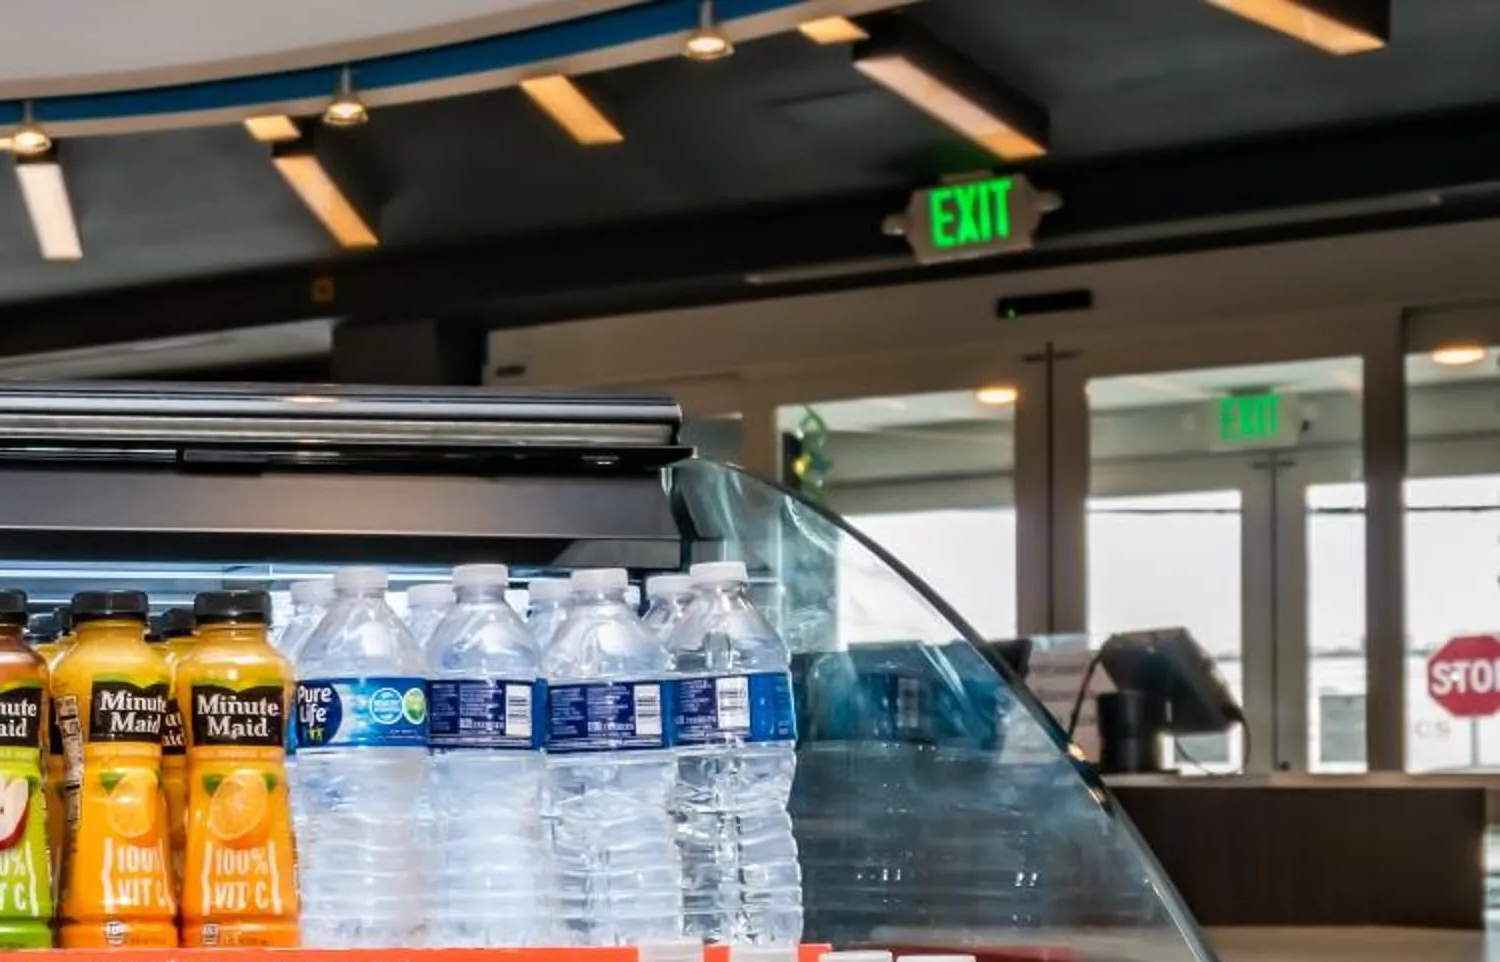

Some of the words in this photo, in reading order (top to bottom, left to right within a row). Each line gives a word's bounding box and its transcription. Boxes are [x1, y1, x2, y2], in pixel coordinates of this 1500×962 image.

[929, 178, 1012, 249] EXIT
[1219, 392, 1281, 441] EXIT
[197, 693, 280, 717] Minute
[298, 685, 332, 704] Pure
[110, 711, 161, 735] Maid
[207, 716, 269, 738] Maid
[299, 703, 327, 725] Life
[215, 847, 269, 876] 100%
[12, 883, 26, 911] C
[119, 879, 150, 907] VIT
[214, 882, 247, 909] VIT
[255, 882, 269, 910] C
